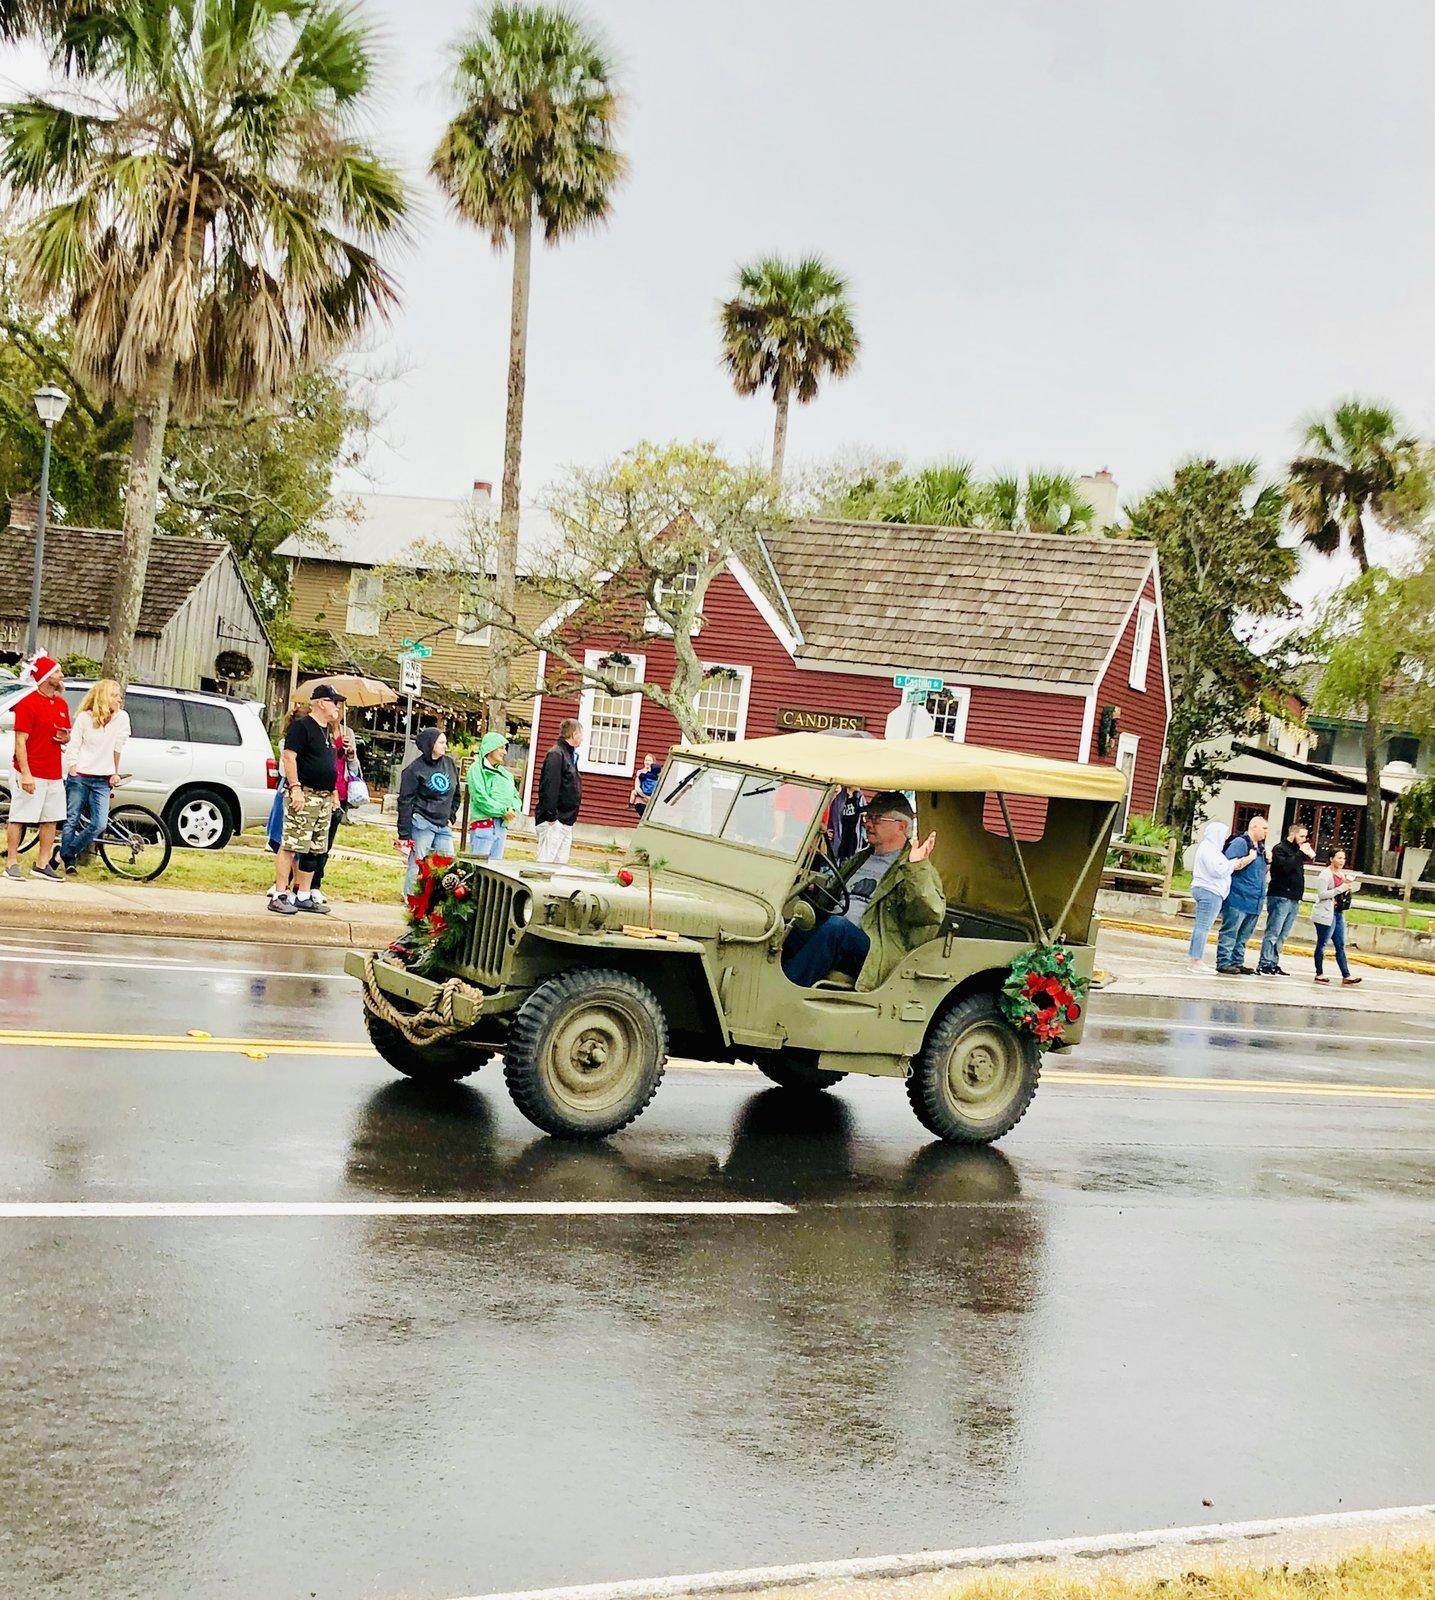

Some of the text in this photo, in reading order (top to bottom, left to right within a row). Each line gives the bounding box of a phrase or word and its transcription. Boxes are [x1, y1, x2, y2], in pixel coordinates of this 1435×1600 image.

[405, 661, 421, 673] ONE
[405, 671, 421, 680] WAY
[905, 677, 932, 689] Castillo
[783, 711, 858, 732] CANDLES
